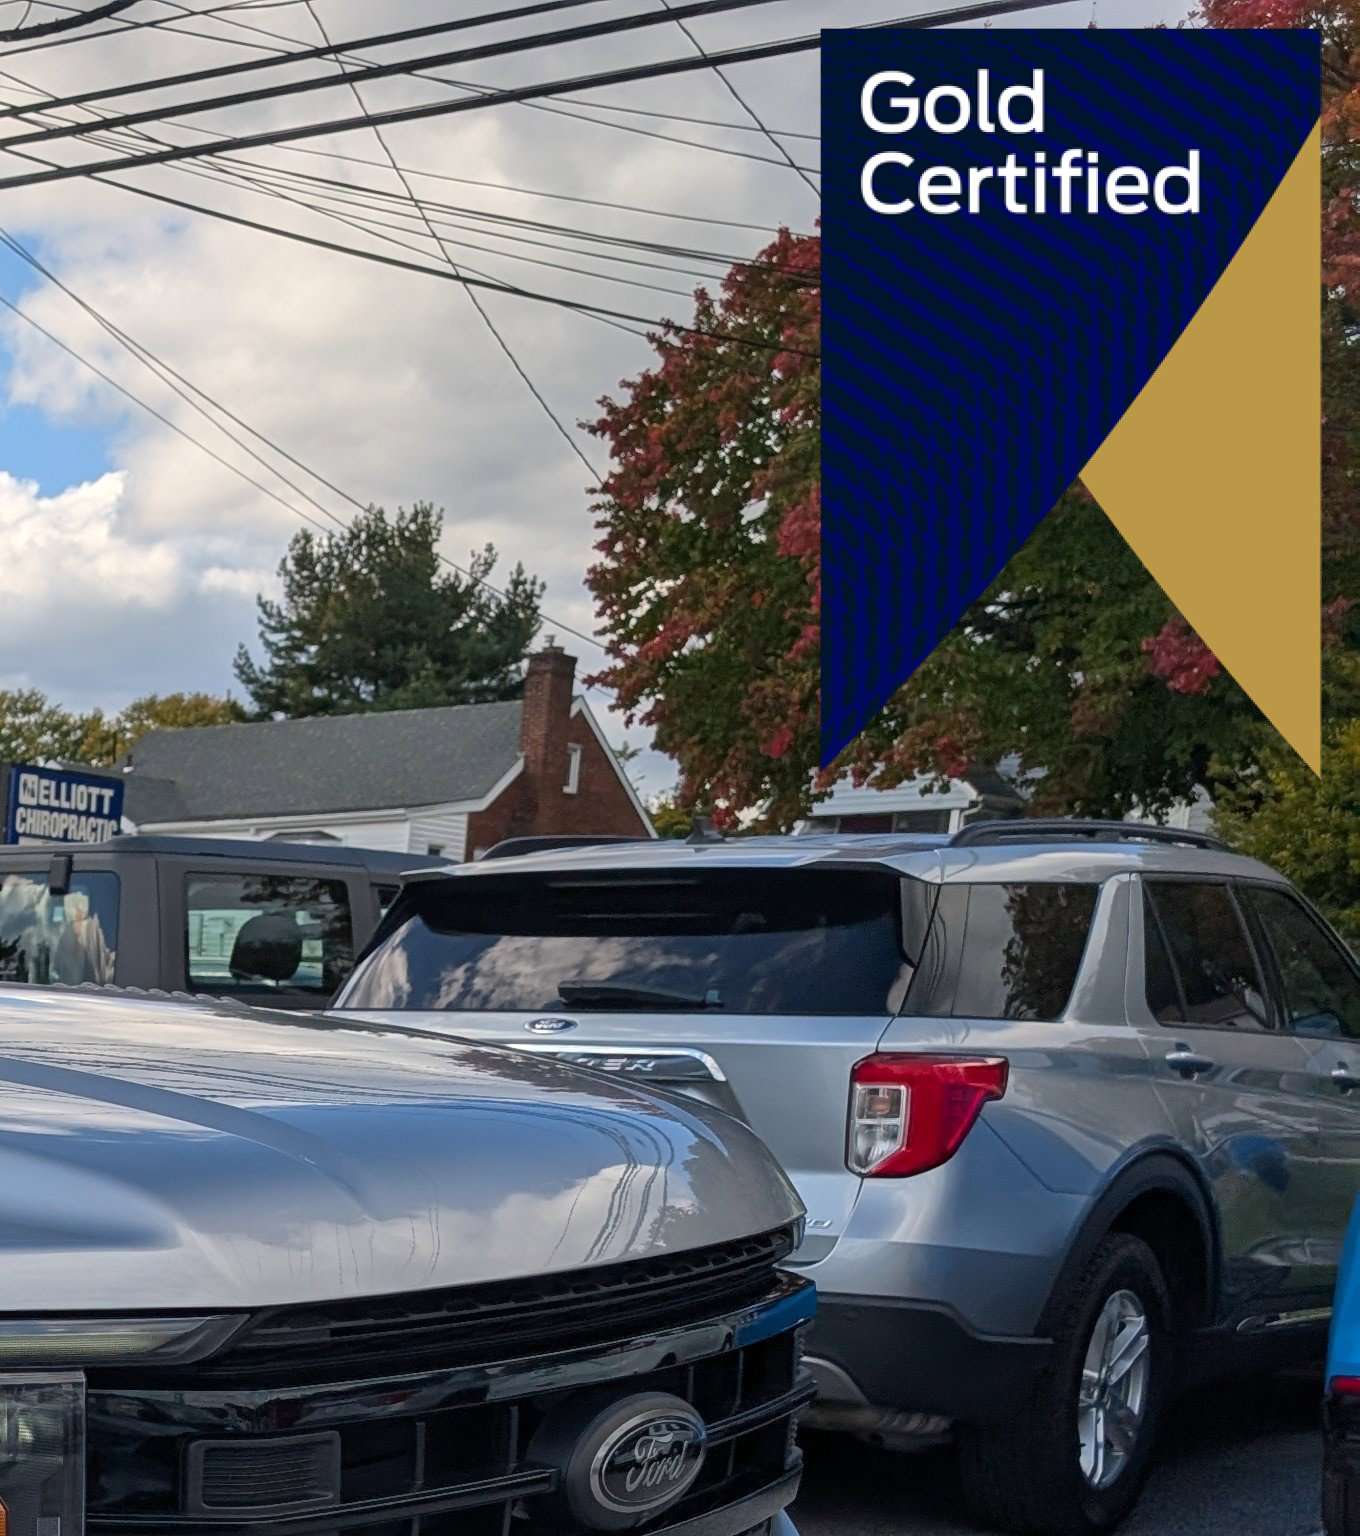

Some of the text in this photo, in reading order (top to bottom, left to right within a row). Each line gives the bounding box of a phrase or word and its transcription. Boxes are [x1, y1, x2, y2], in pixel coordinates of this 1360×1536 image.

[38, 778, 115, 815] ELLIOTT
[15, 806, 118, 843] CHIROPRACTIC
[626, 1432, 688, 1493] Ford
